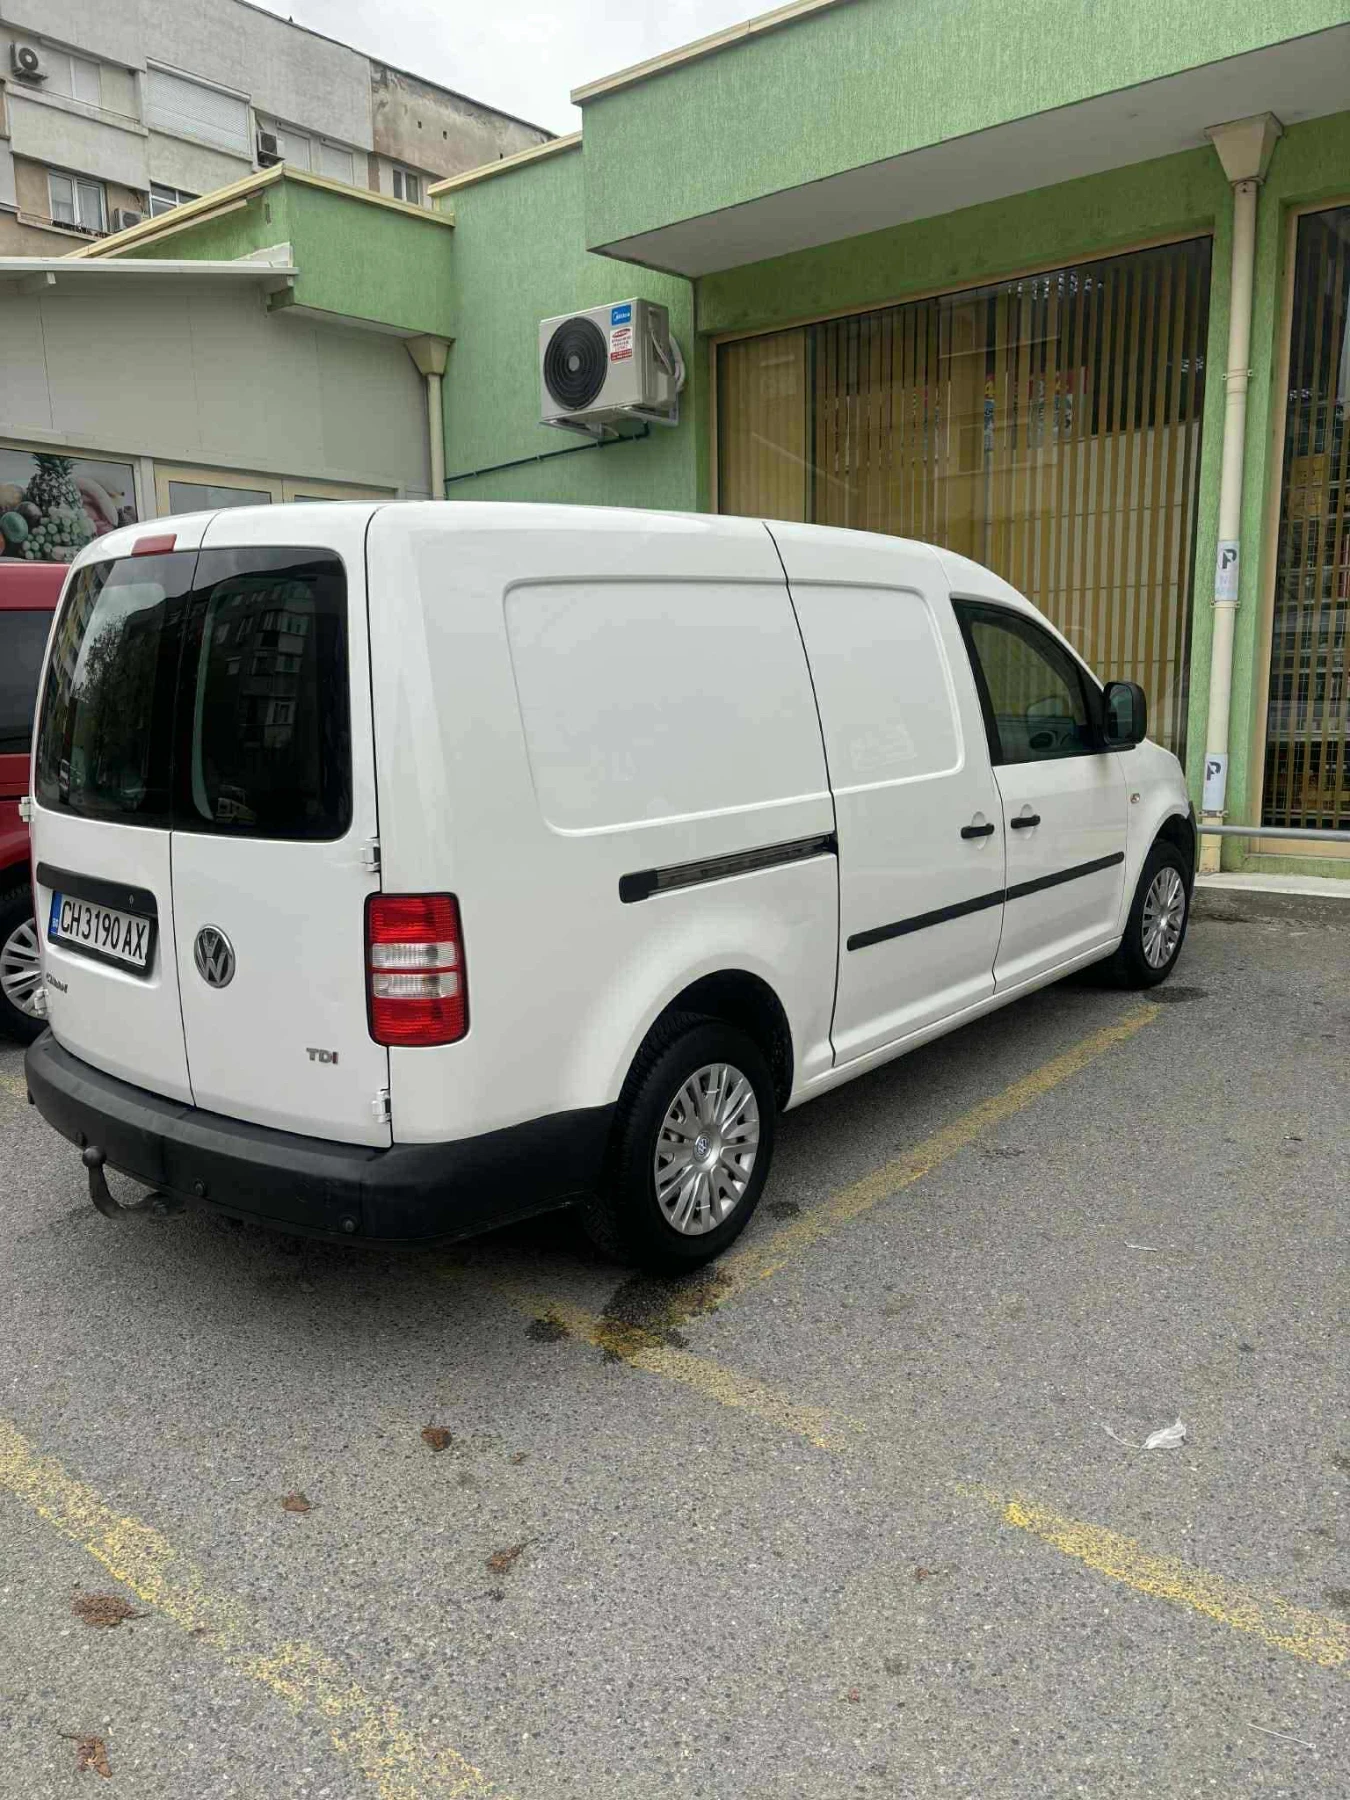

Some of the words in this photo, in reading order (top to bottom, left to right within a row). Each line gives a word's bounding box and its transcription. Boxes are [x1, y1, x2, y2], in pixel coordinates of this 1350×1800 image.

[1222, 549, 1237, 569] P
[1206, 761, 1222, 781] P
[61, 900, 82, 936] CH
[82, 907, 120, 950] 3190
[121, 920, 146, 960] AX
[306, 1047, 339, 1065] TDI
